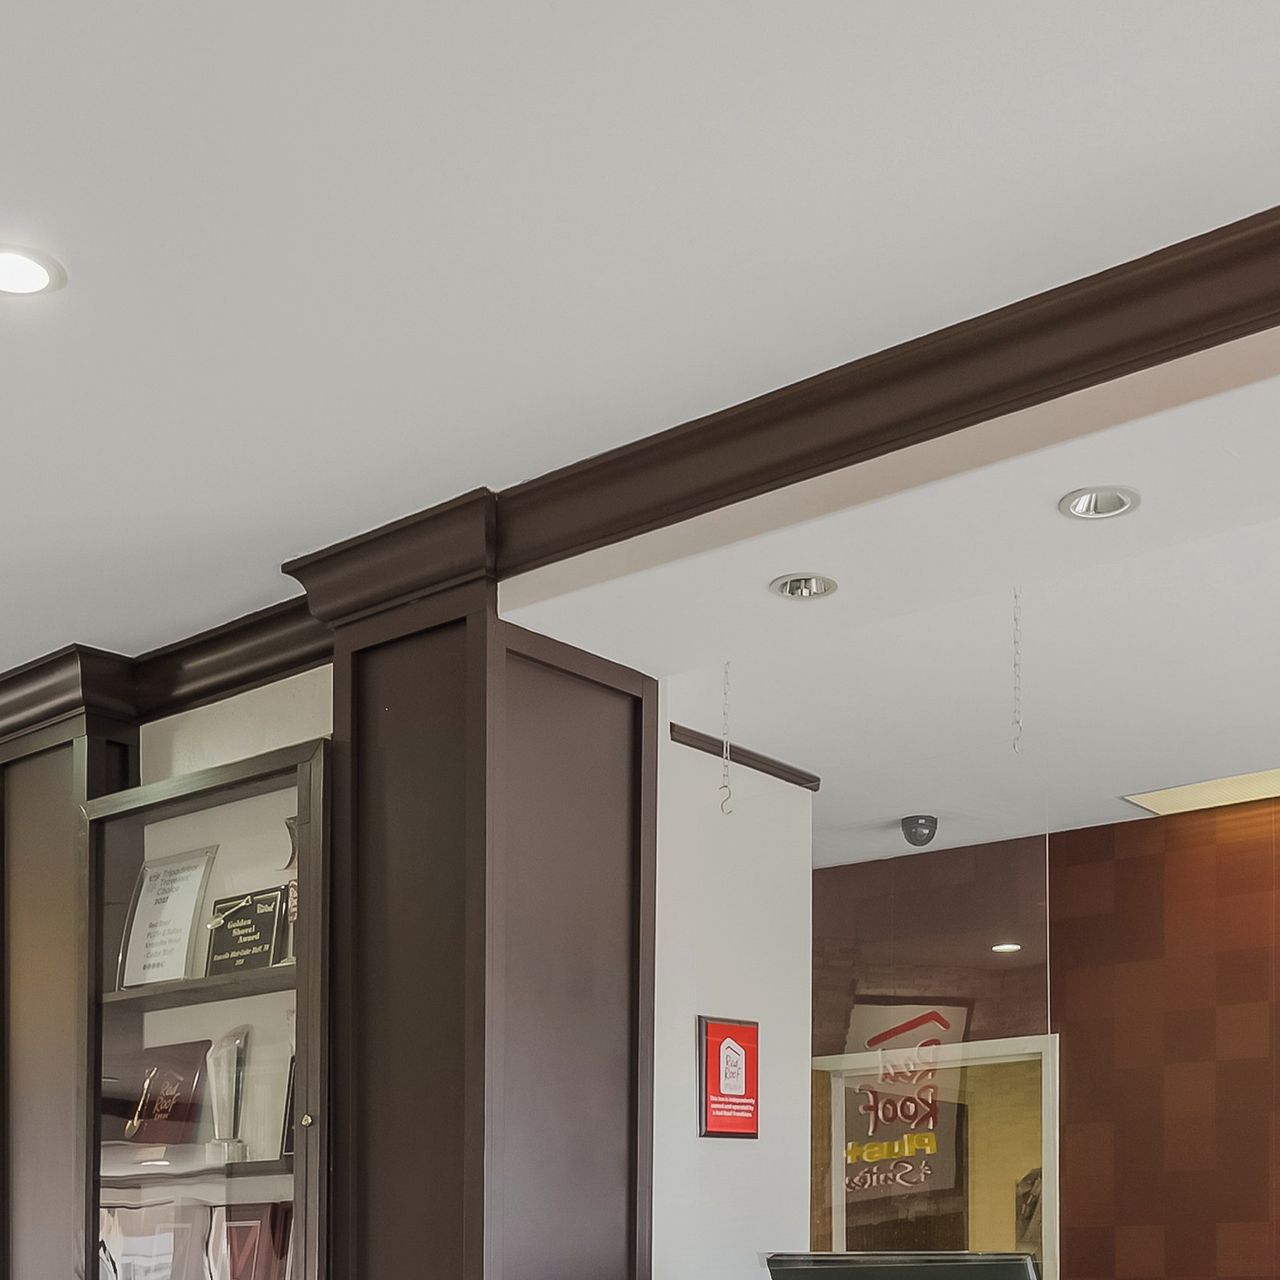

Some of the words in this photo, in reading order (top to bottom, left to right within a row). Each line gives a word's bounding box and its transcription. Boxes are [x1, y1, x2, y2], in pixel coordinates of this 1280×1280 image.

[227, 919, 252, 929] Golden
[232, 925, 255, 936] Shovel
[238, 932, 260, 943] Award
[725, 1054, 738, 1068] Red
[724, 1067, 741, 1082] Roof
[160, 1081, 179, 1096] Red
[153, 1093, 181, 1113] Roof
